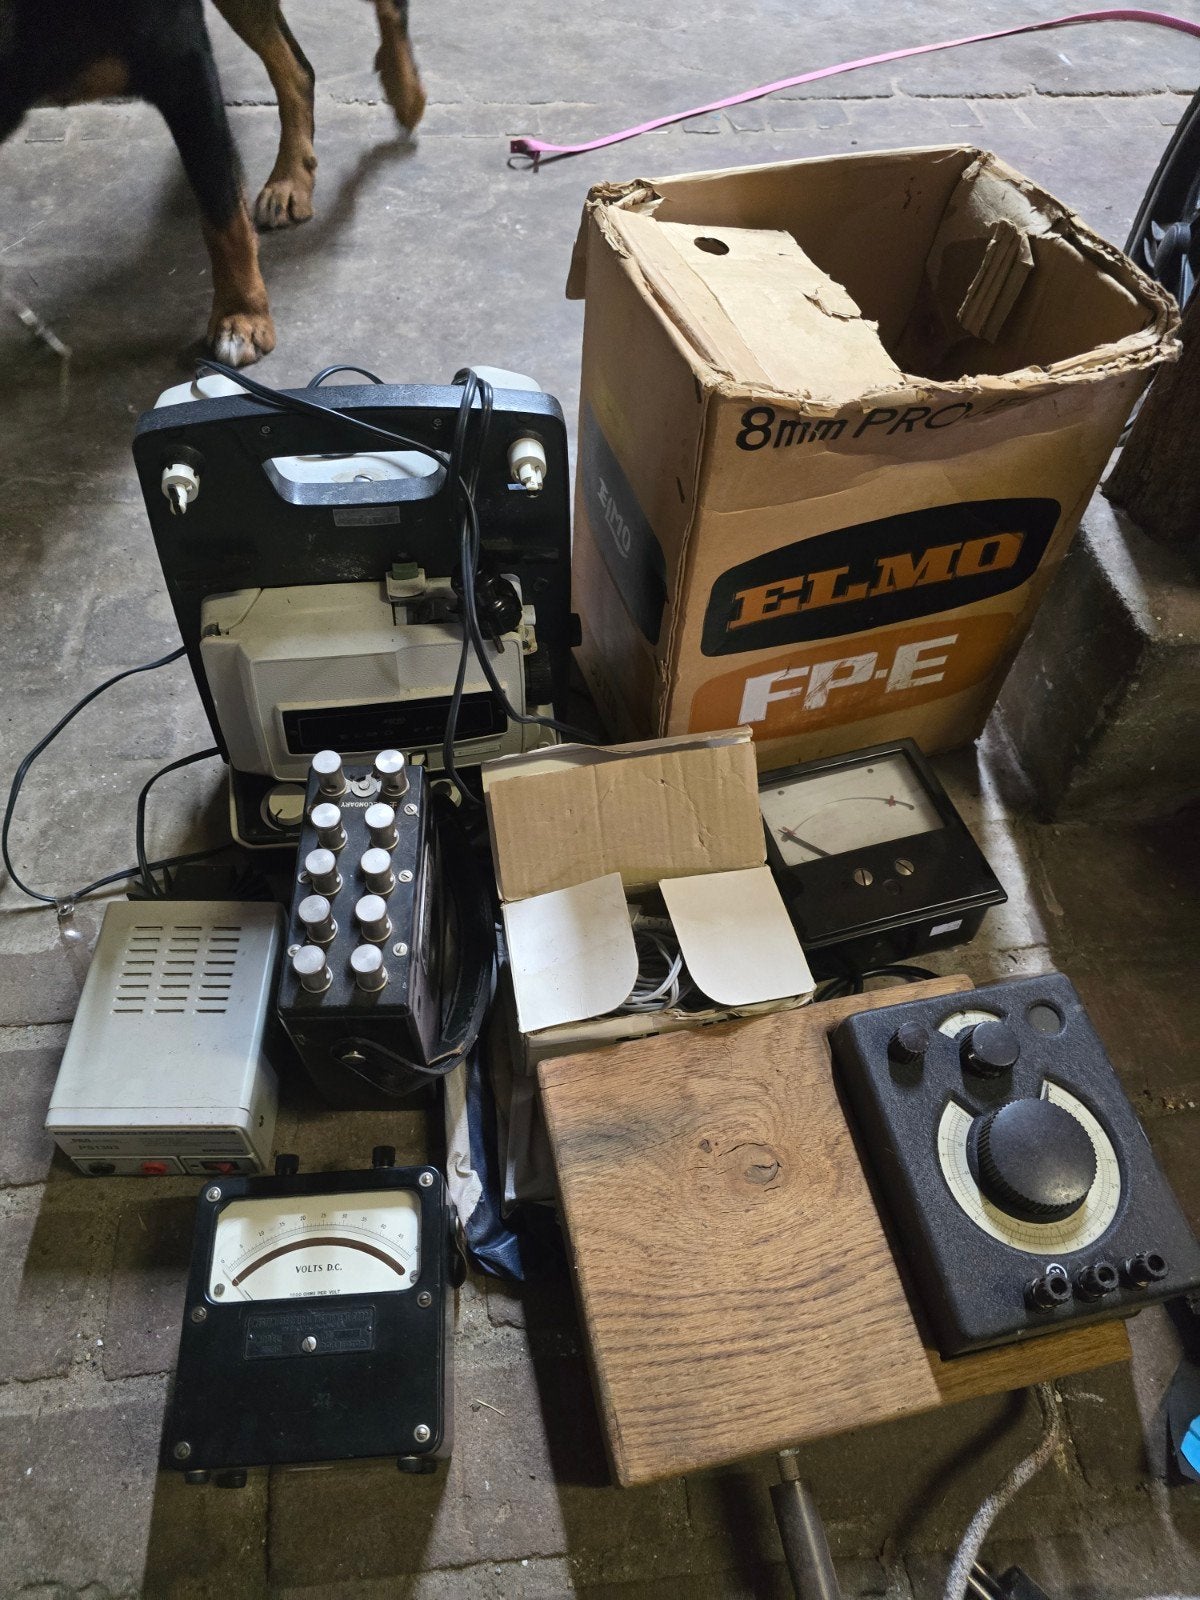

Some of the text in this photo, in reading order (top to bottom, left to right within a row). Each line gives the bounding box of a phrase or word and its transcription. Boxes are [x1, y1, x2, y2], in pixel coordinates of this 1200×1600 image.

[735, 406, 848, 451] 8mm
[597, 476, 631, 558] ELMO
[726, 532, 1025, 632] ELMO
[737, 633, 959, 726] FP-E
[295, 1262, 343, 1274] VOLTS D.C.
